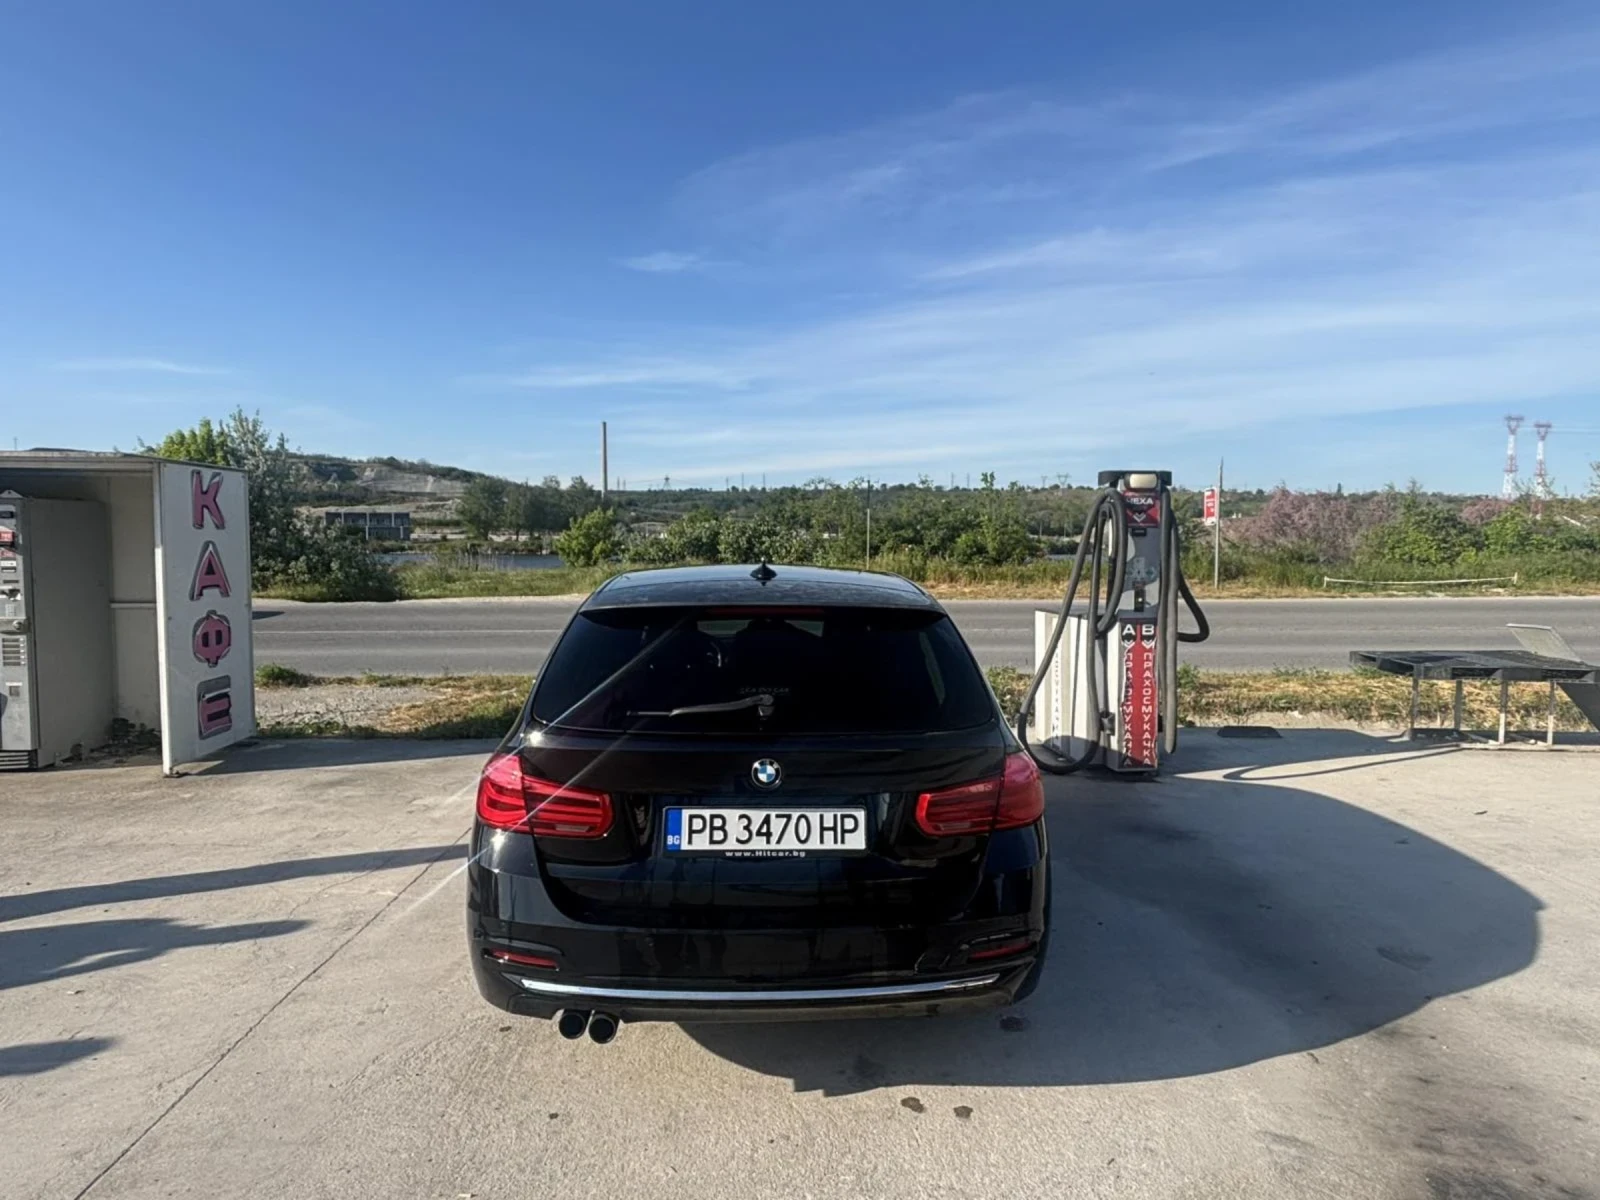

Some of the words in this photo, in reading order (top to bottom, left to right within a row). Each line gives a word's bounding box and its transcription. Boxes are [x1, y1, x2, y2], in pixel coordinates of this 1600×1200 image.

[189, 469, 232, 740] КАФЕ
[1141, 652, 1153, 765] ПРАХОСМУКАЧКА
[667, 835, 680, 845] BG
[687, 814, 728, 845] PB
[735, 814, 811, 845] 3470
[819, 814, 859, 845] HP
[725, 850, 807, 858] www.Hitcar.bg
